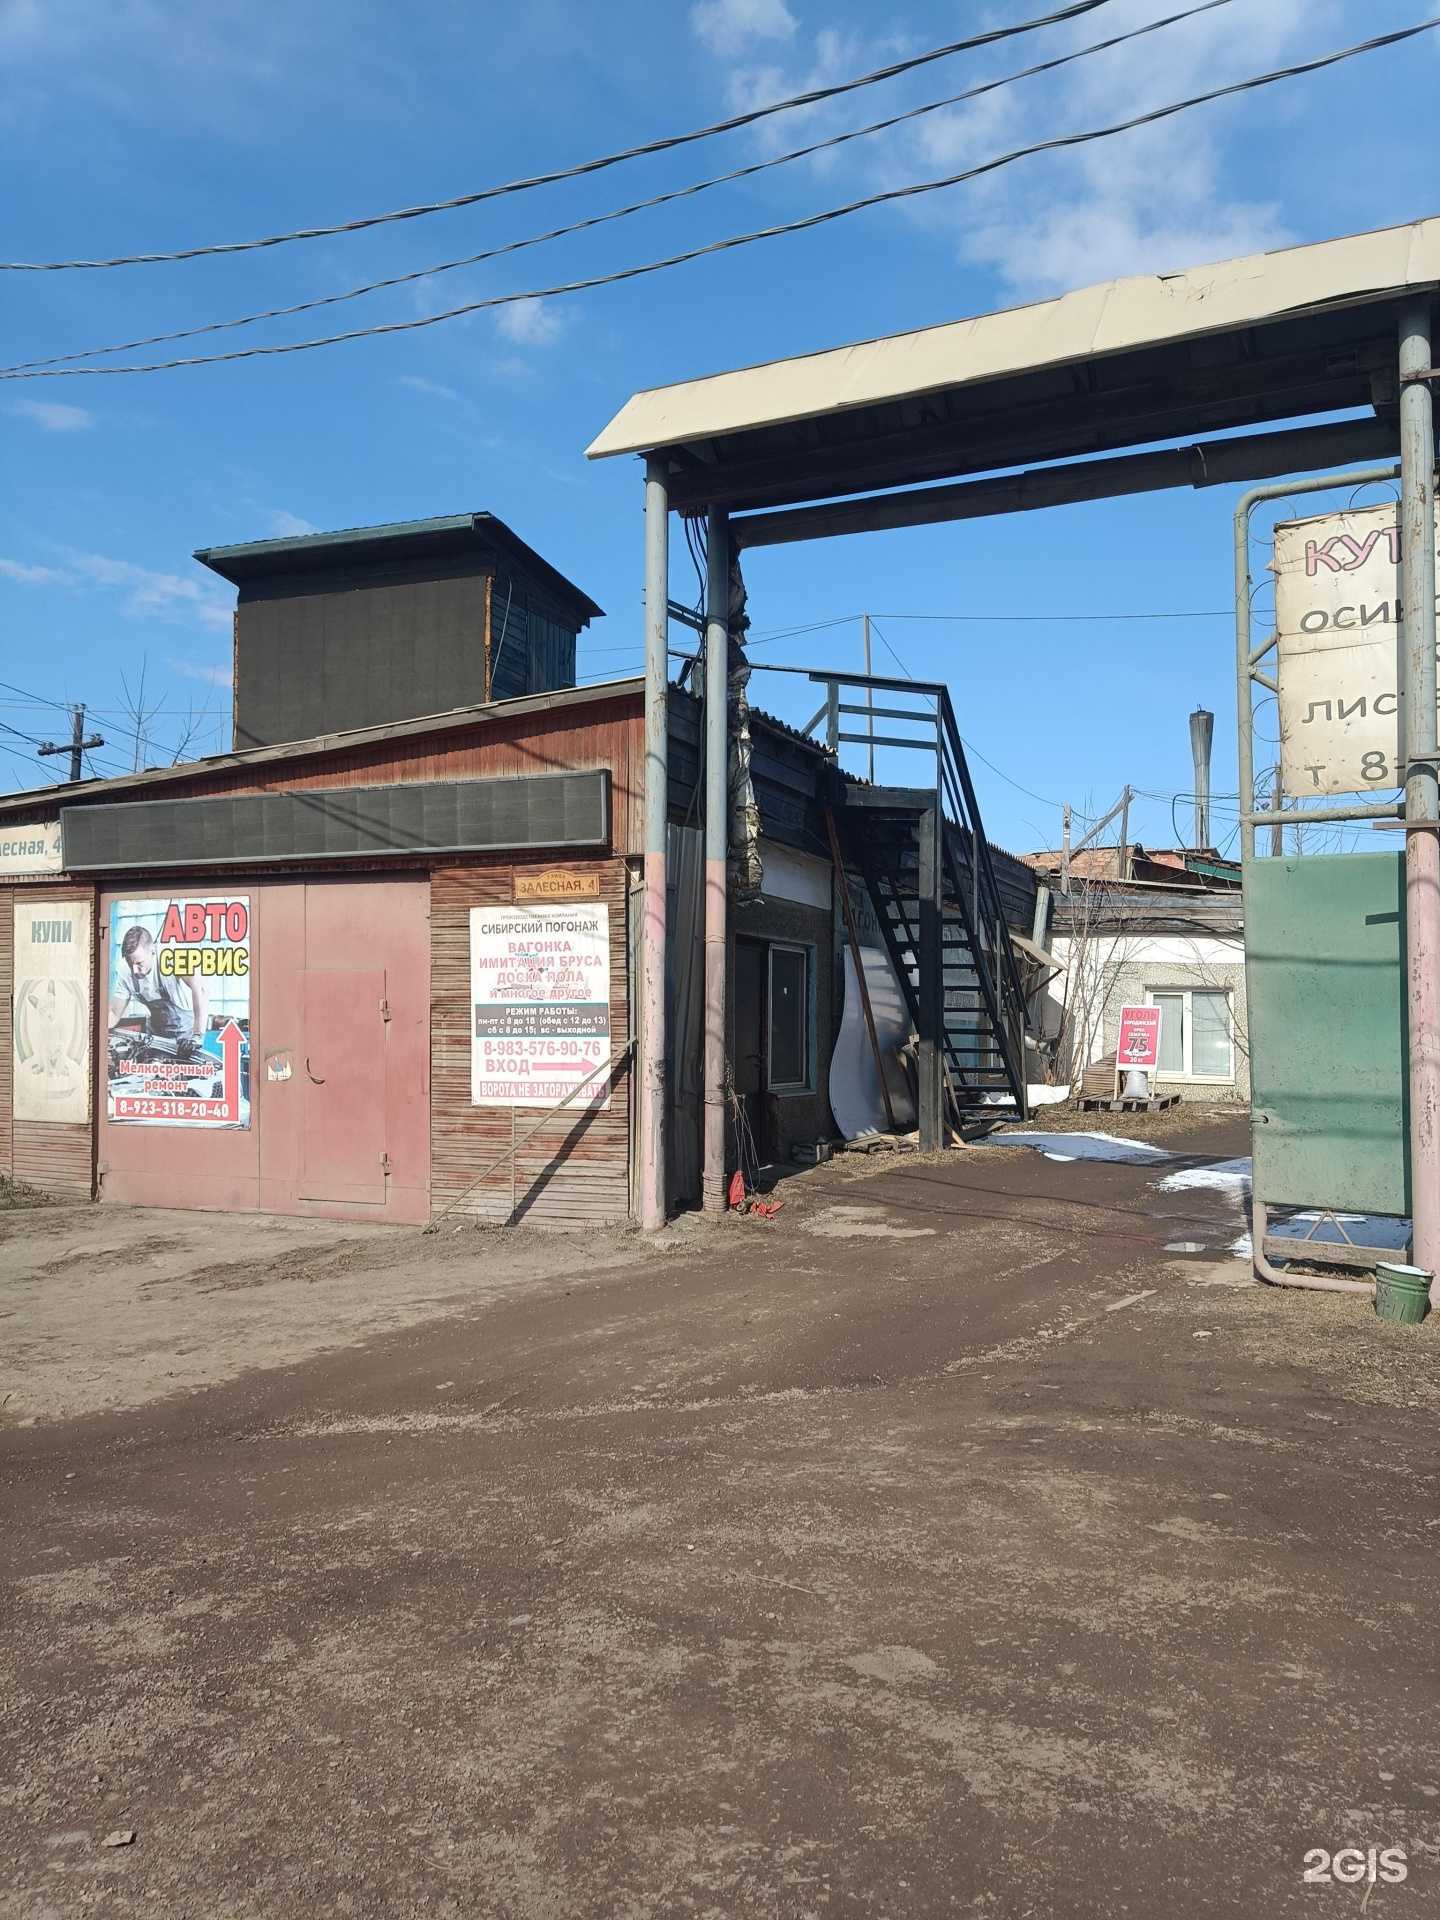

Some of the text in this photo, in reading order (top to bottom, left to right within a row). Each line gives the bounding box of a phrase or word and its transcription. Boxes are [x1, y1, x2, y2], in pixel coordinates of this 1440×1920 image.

[1360, 751, 1389, 781] 8
[0, 838, 48, 857] есная,
[588, 879, 595, 891] 4
[160, 902, 248, 944] АВТО
[481, 920, 599, 934] СИБИРСКИЙ ПОГОНАЖ
[31, 920, 73, 943] КУПИ
[508, 940, 572, 953] ВАГОНКА
[159, 948, 249, 977] СЕРВИС
[559, 955, 602, 968] БРУСА
[496, 970, 584, 985] ДОСКА ПОЛА
[505, 1007, 578, 1016] РЕЖИМ РАБОТЫ:
[513, 1018, 524, 1026] до
[570, 1016, 580, 1024] 12
[582, 1017, 593, 1025] до
[594, 1016, 607, 1025] 13)
[556, 1025, 597, 1033] выходной
[484, 1041, 601, 1056] 8-983-576-90-76
[1128, 1038, 1148, 1051] 75
[119, 1060, 215, 1078] Мелкосрочный
[485, 1058, 530, 1075] ВХОД
[143, 1080, 188, 1092] ремонт
[481, 1082, 516, 1097] ВОРОТА
[519, 1082, 530, 1097] НЕ
[119, 1100, 229, 1117] 8-923-318-20-40
